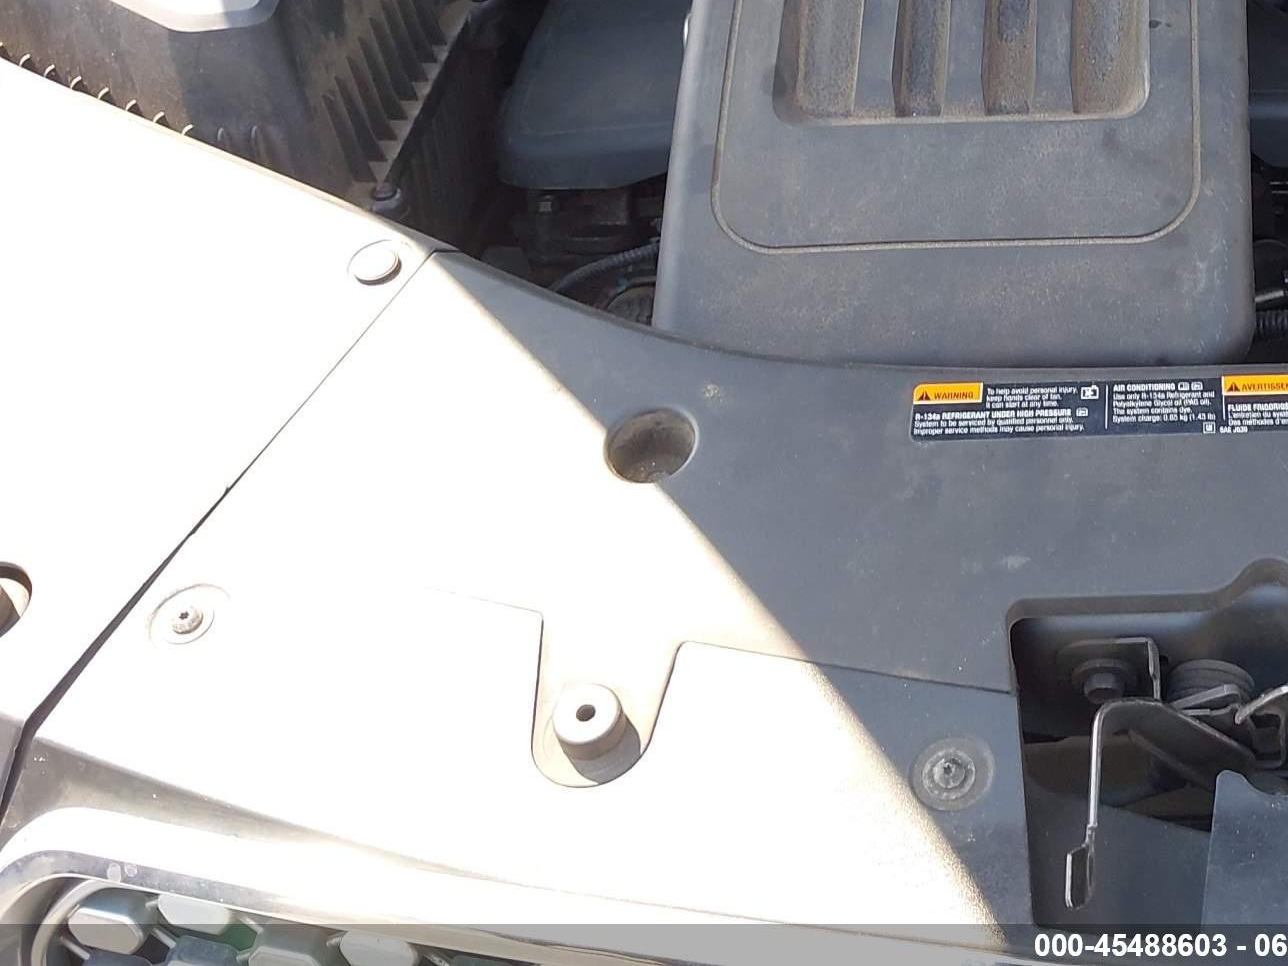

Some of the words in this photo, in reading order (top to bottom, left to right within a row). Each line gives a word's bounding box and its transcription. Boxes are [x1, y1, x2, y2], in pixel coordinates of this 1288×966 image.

[995, 387, 1009, 396] help
[1011, 386, 1028, 395] avoid
[1029, 386, 1057, 396] personal
[1113, 384, 1125, 392] AIR
[1127, 382, 1175, 392] CONDITIONING
[934, 392, 973, 400] WARNING
[1203, 390, 1215, 398] and
[1227, 403, 1252, 412] FLUIDE
[915, 412, 940, 421] R-134a
[942, 411, 990, 420] REFRIGERANT
[991, 410, 1015, 418] UNDER
[1017, 409, 1034, 418] HIGH
[1035, 408, 1071, 417] PRESSURE
[914, 420, 939, 429] System
[958, 419, 986, 427] serviced
[987, 419, 995, 427] by
[996, 417, 1024, 426] qualified
[1026, 416, 1057, 425] personnel
[914, 427, 943, 436] Improper
[970, 426, 998, 434] methods
[999, 425, 1013, 434] may
[1015, 425, 1034, 433] cause
[1036, 424, 1063, 433] personal
